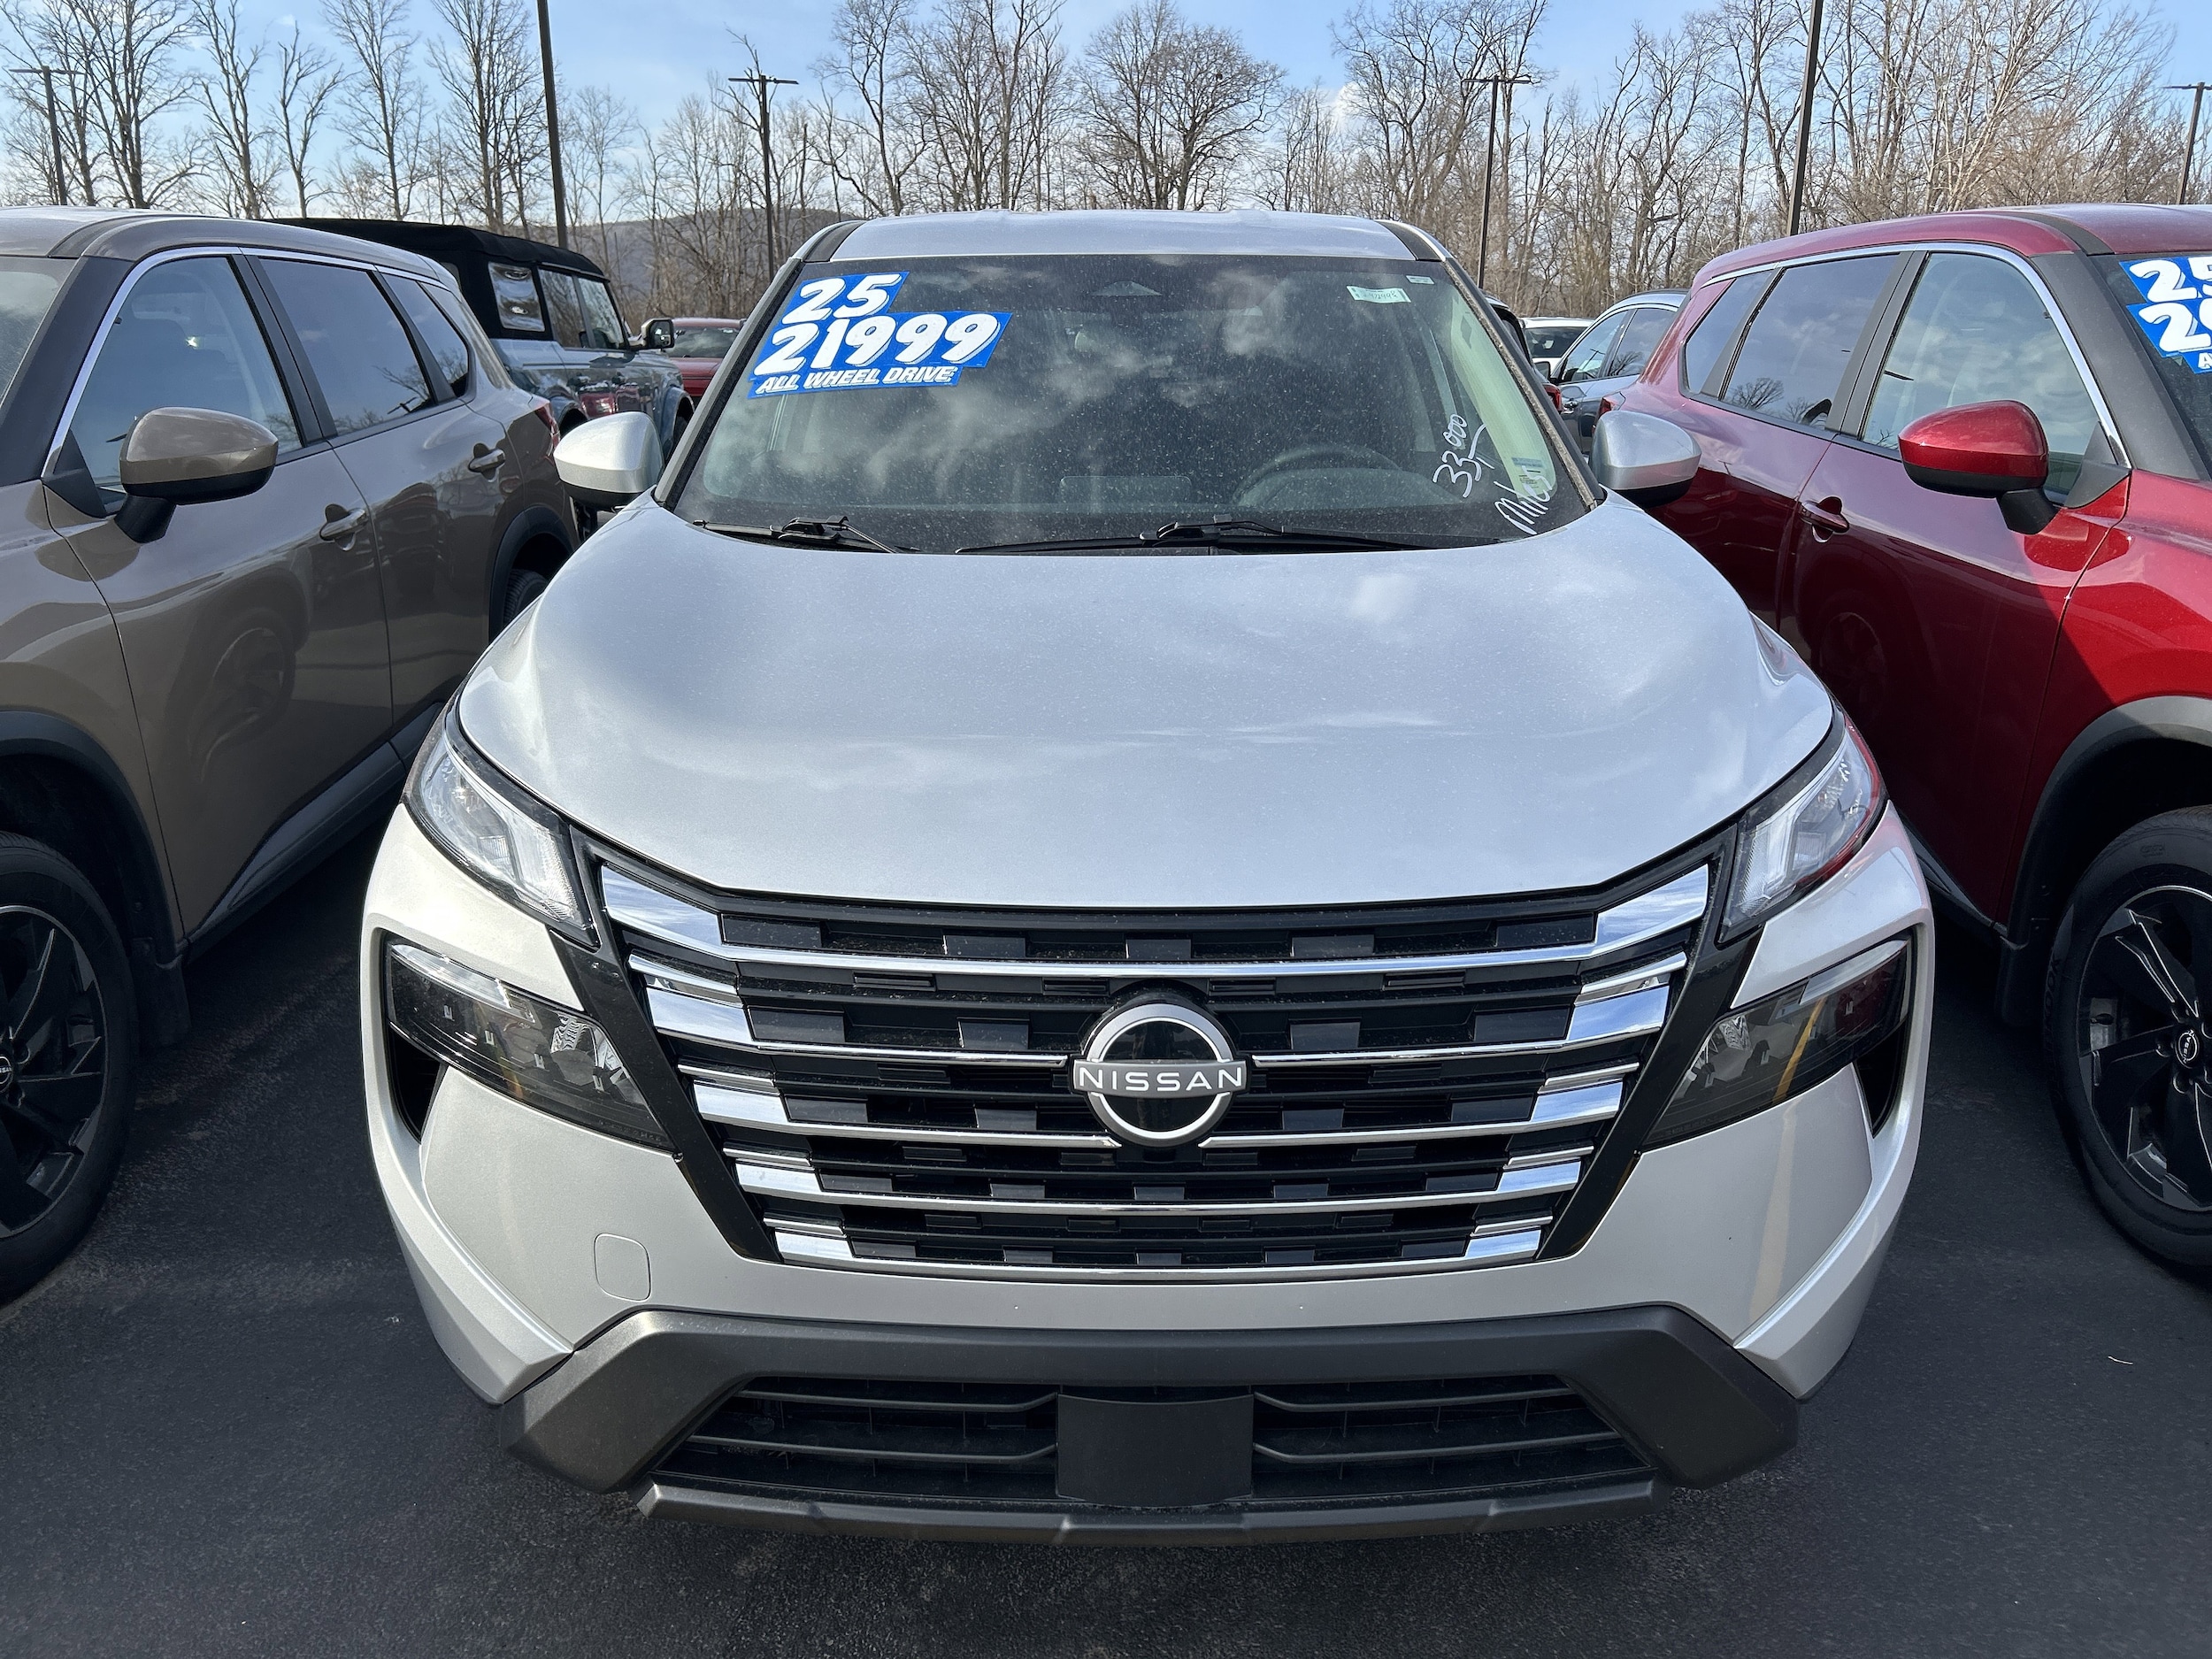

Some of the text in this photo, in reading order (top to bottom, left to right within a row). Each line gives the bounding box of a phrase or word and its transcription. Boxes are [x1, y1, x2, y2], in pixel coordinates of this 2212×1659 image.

[782, 273, 902, 324] 25
[754, 313, 1001, 376] 21999
[755, 365, 958, 395] ALL WHEEL DRIVE
[2182, 1028, 2195, 1064] NISSAN
[1079, 1066, 1242, 1093] NISSAN
